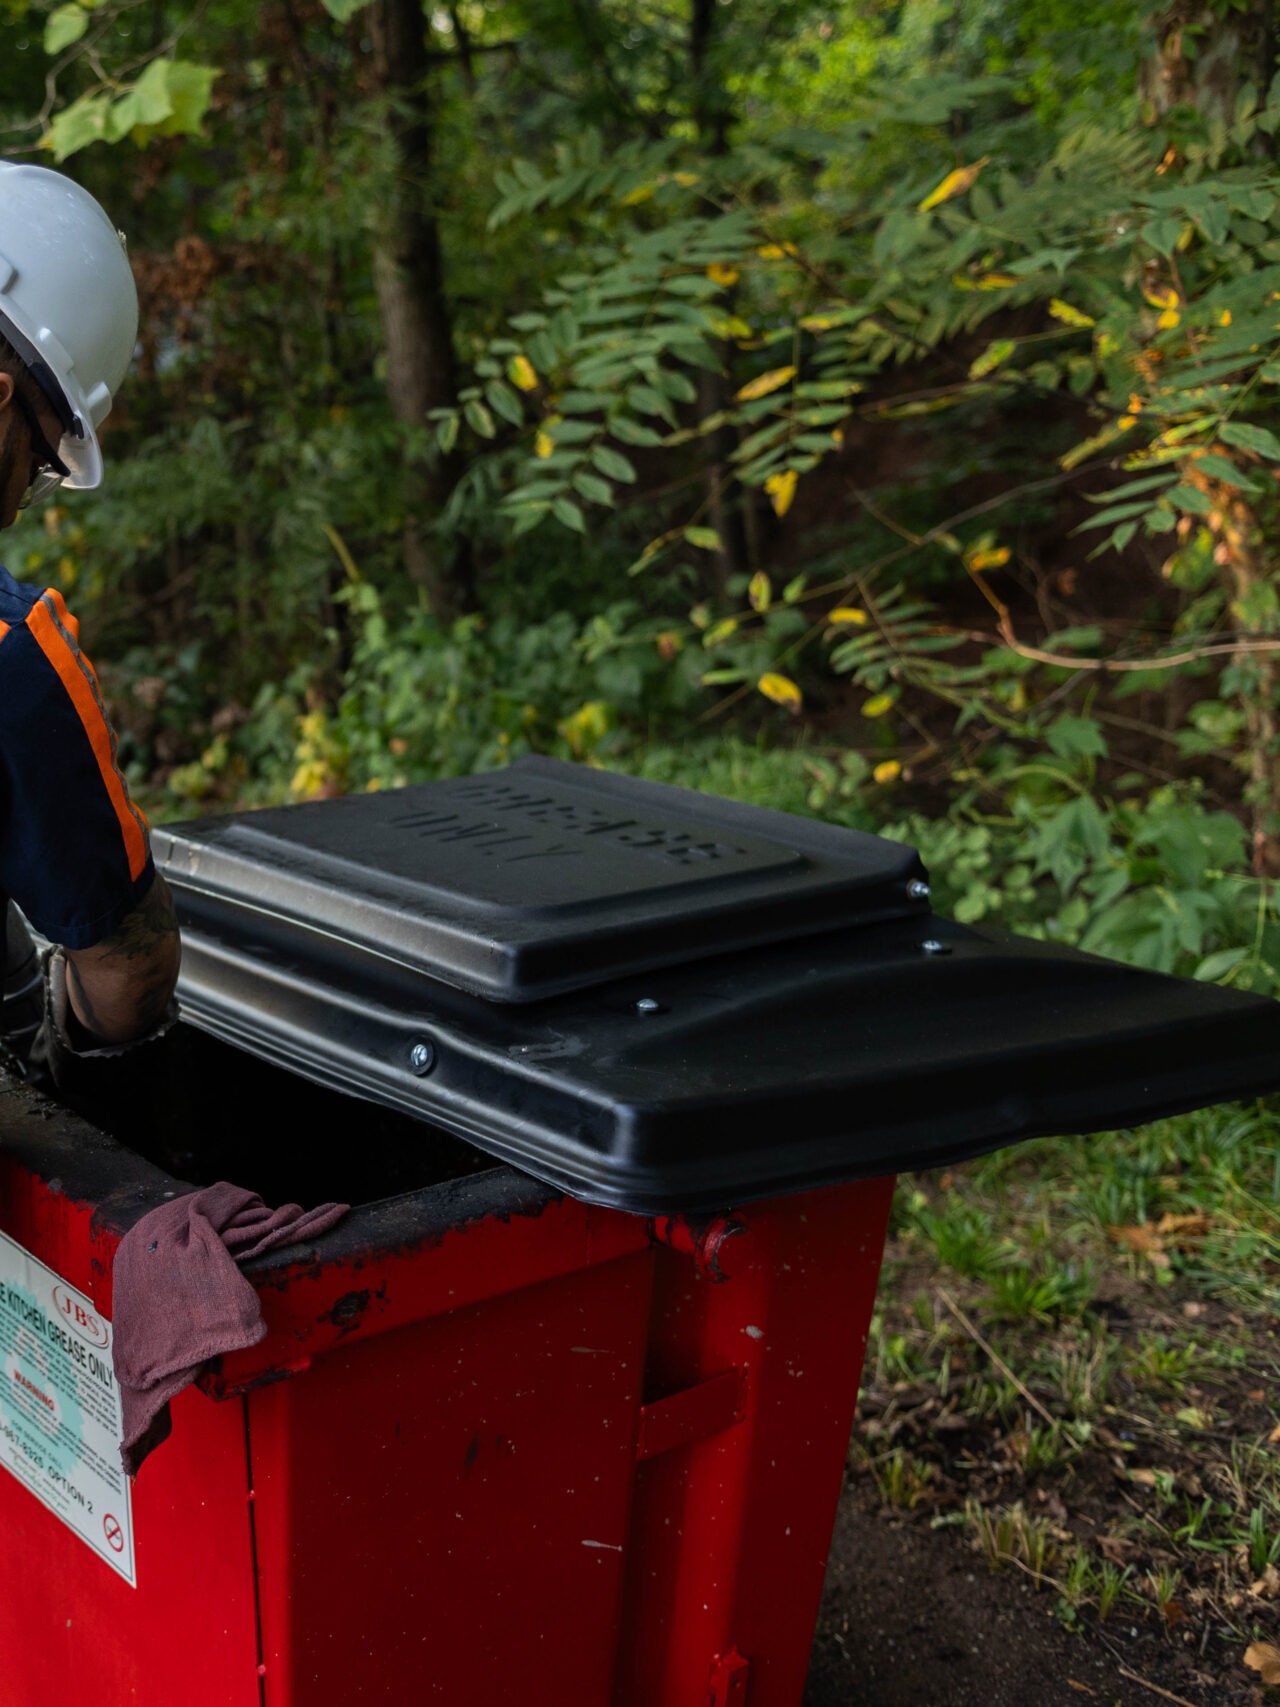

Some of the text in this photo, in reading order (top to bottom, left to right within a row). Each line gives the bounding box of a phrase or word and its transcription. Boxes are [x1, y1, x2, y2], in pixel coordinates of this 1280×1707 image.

[7, 1286, 47, 1336] KITCHEN
[48, 1320, 87, 1368] GREASE
[88, 1352, 113, 1389] ONLY
[62, 1296, 99, 1337] JBS
[14, 1368, 54, 1411] WARNING
[47, 1465, 85, 1507] OPTION
[87, 1500, 94, 1514] 2
